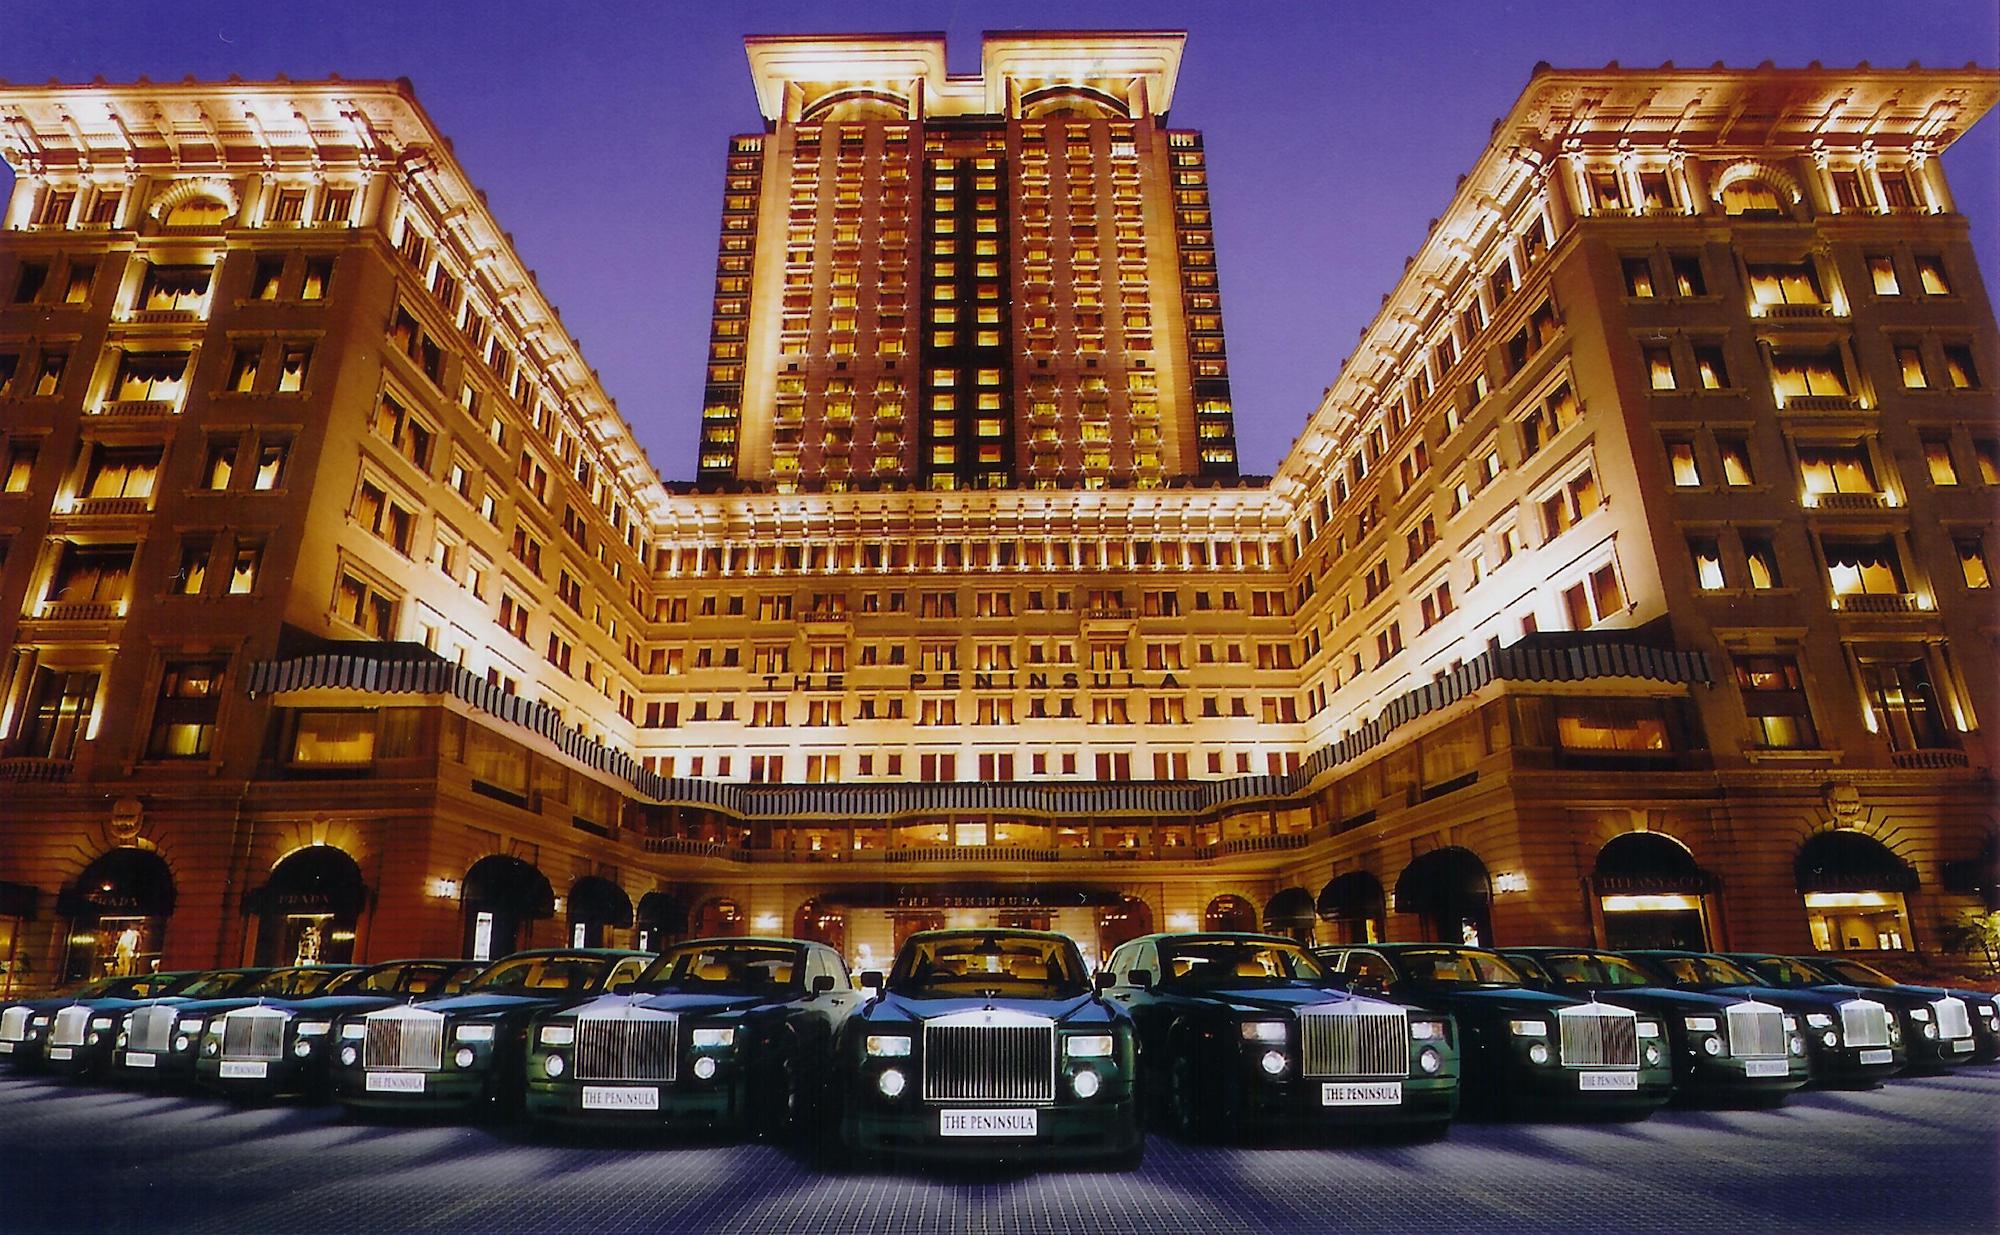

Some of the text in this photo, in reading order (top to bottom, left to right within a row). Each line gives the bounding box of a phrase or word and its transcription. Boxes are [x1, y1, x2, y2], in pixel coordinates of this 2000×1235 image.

[762, 673, 1180, 691] THE PENINSULA
[278, 894, 331, 905] PRADA
[897, 896, 1041, 907] THE PENINSULA
[369, 1077, 422, 1089] THE PENINSULA
[1582, 1076, 1636, 1086] THE PENINSULA
[584, 1092, 656, 1105] THE PENINSULA
[1325, 1088, 1399, 1100] THE PENINSULA
[944, 1115, 1034, 1129] THE PENINSULA
